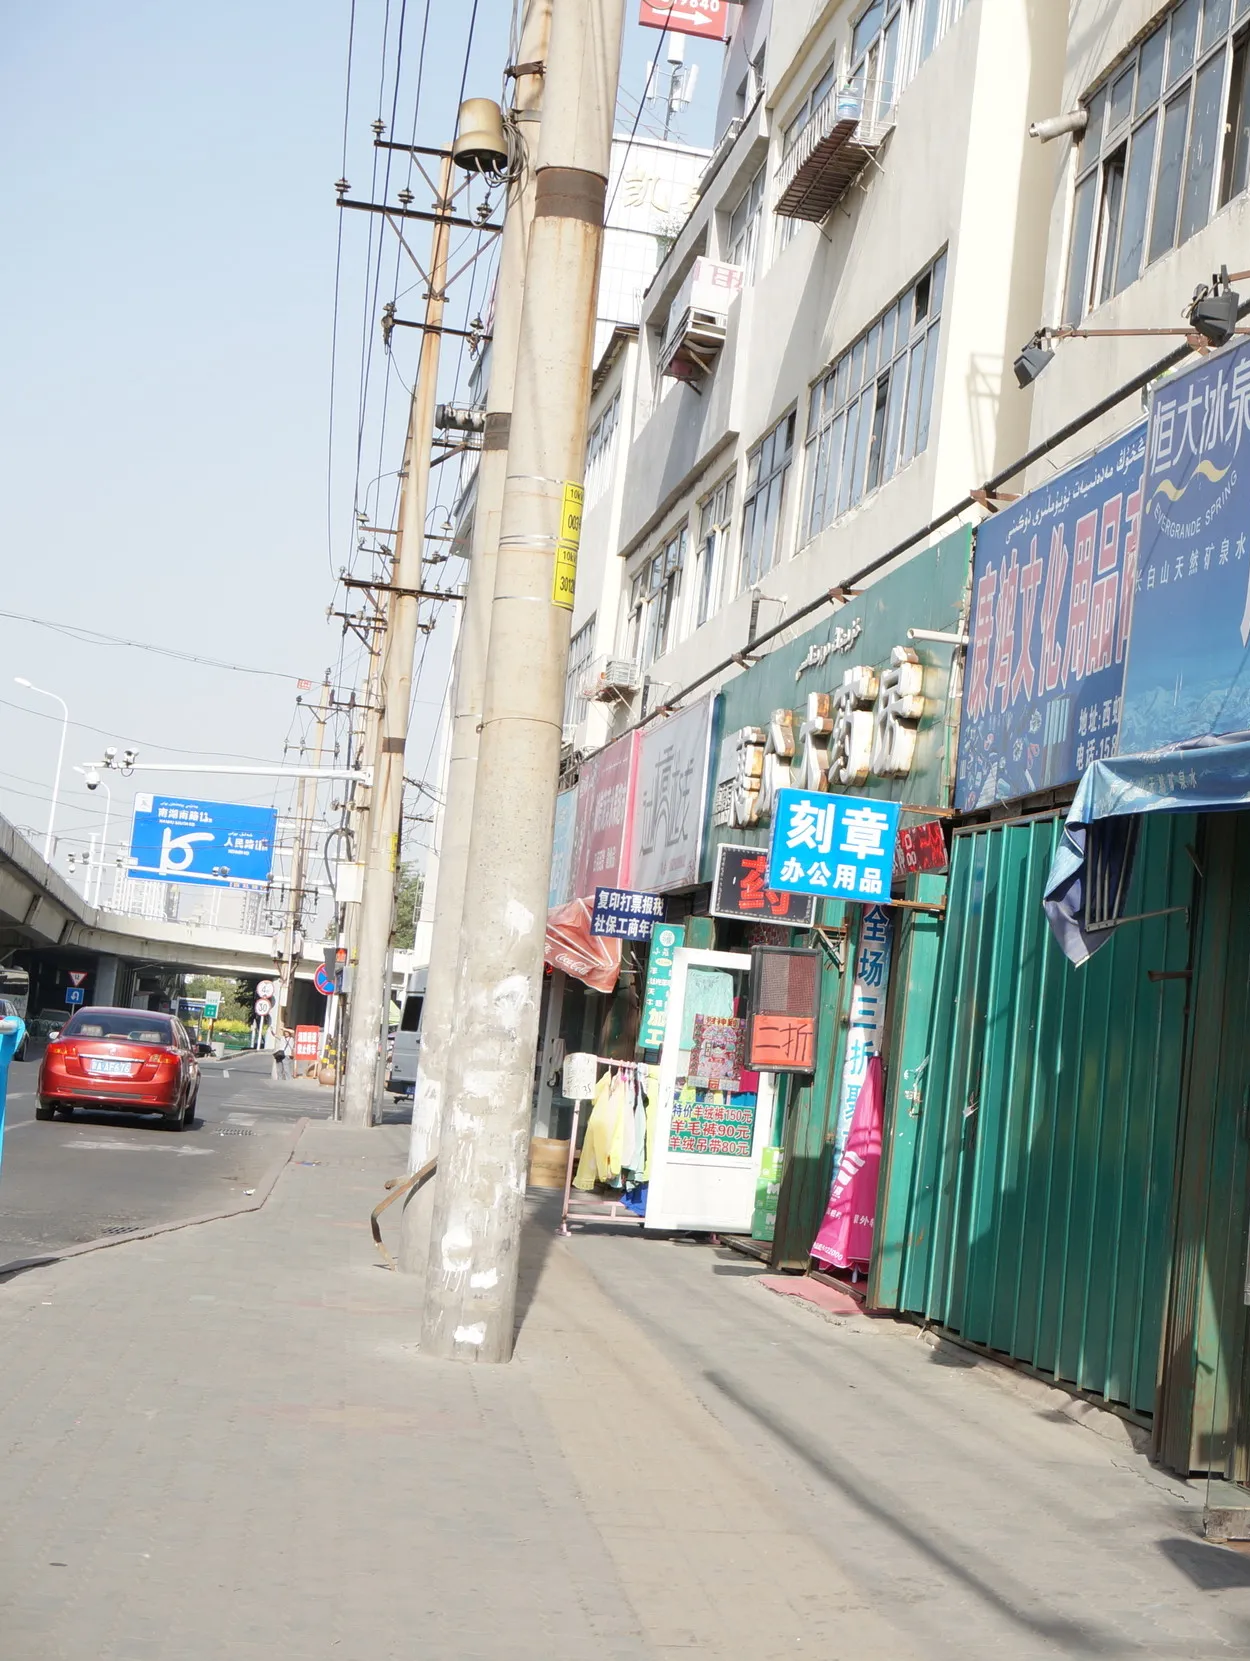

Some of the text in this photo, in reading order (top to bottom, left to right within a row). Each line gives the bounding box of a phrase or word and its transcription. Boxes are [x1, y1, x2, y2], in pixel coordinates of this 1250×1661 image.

[1153, 469, 1239, 541] EVERGRANDE SPRING
[1134, 531, 1248, 594] 长白山天然矿泉水
[785, 799, 890, 860] 刻章
[780, 856, 883, 894] 办公用品
[594, 914, 655, 939] 社保工商年
[259, 1001, 268, 1010] 30
[755, 1022, 813, 1062] 二折
[669, 1136, 751, 1158] 羊绒吊带80元
[670, 1119, 752, 1140] 羊毛裤90元
